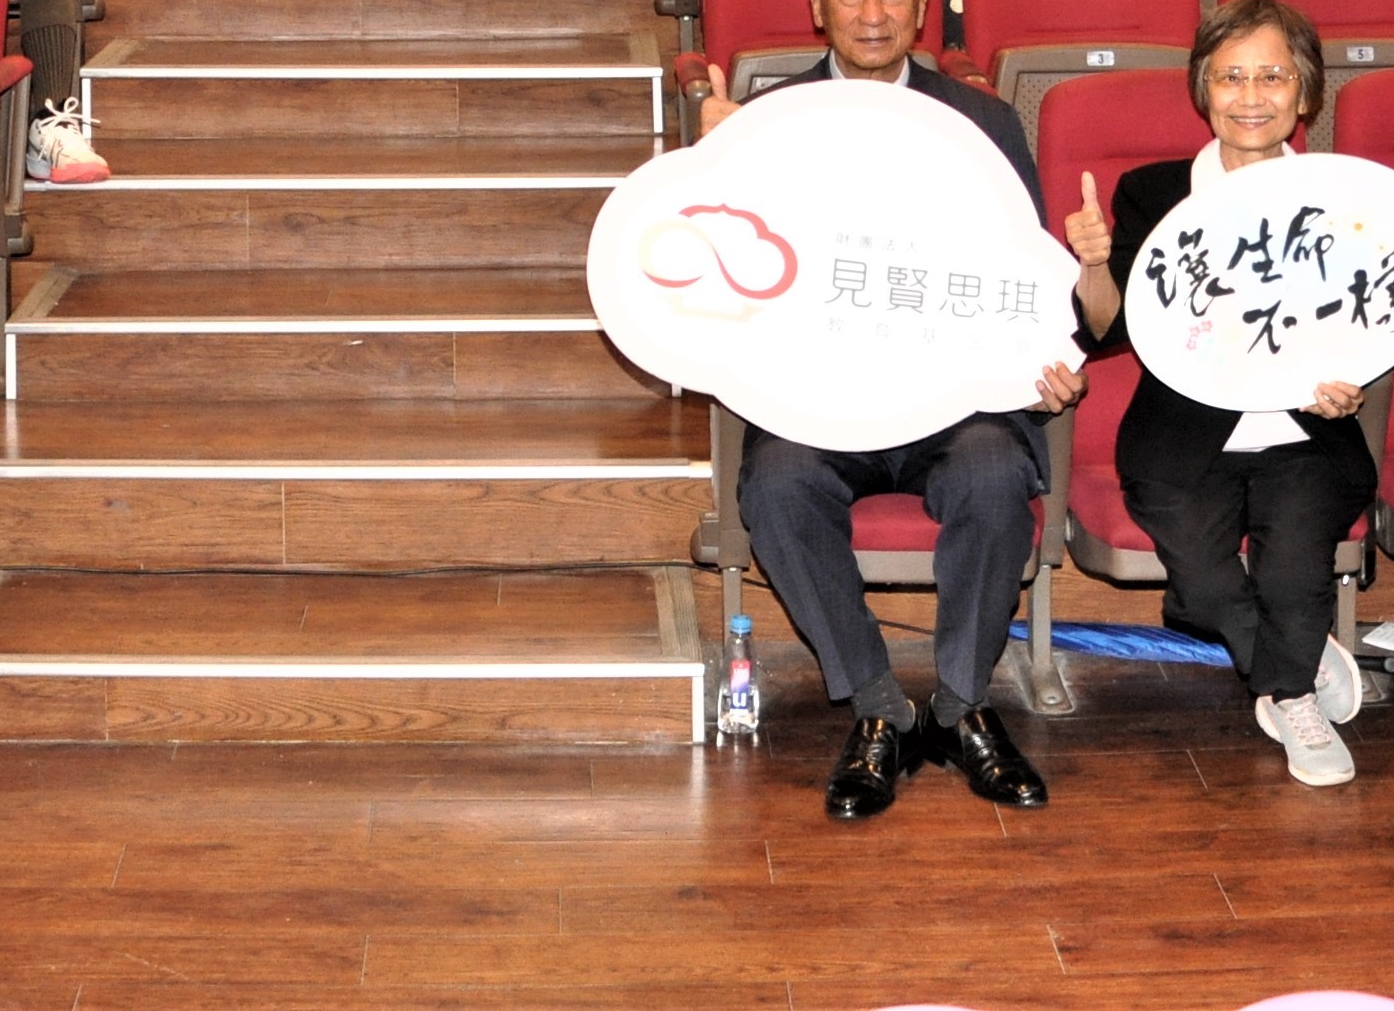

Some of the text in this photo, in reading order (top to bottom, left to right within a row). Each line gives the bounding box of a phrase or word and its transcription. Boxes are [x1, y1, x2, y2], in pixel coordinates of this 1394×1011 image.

[824, 257, 1039, 324] 見賢思琪
[1145, 206, 1335, 317] 讓生命
